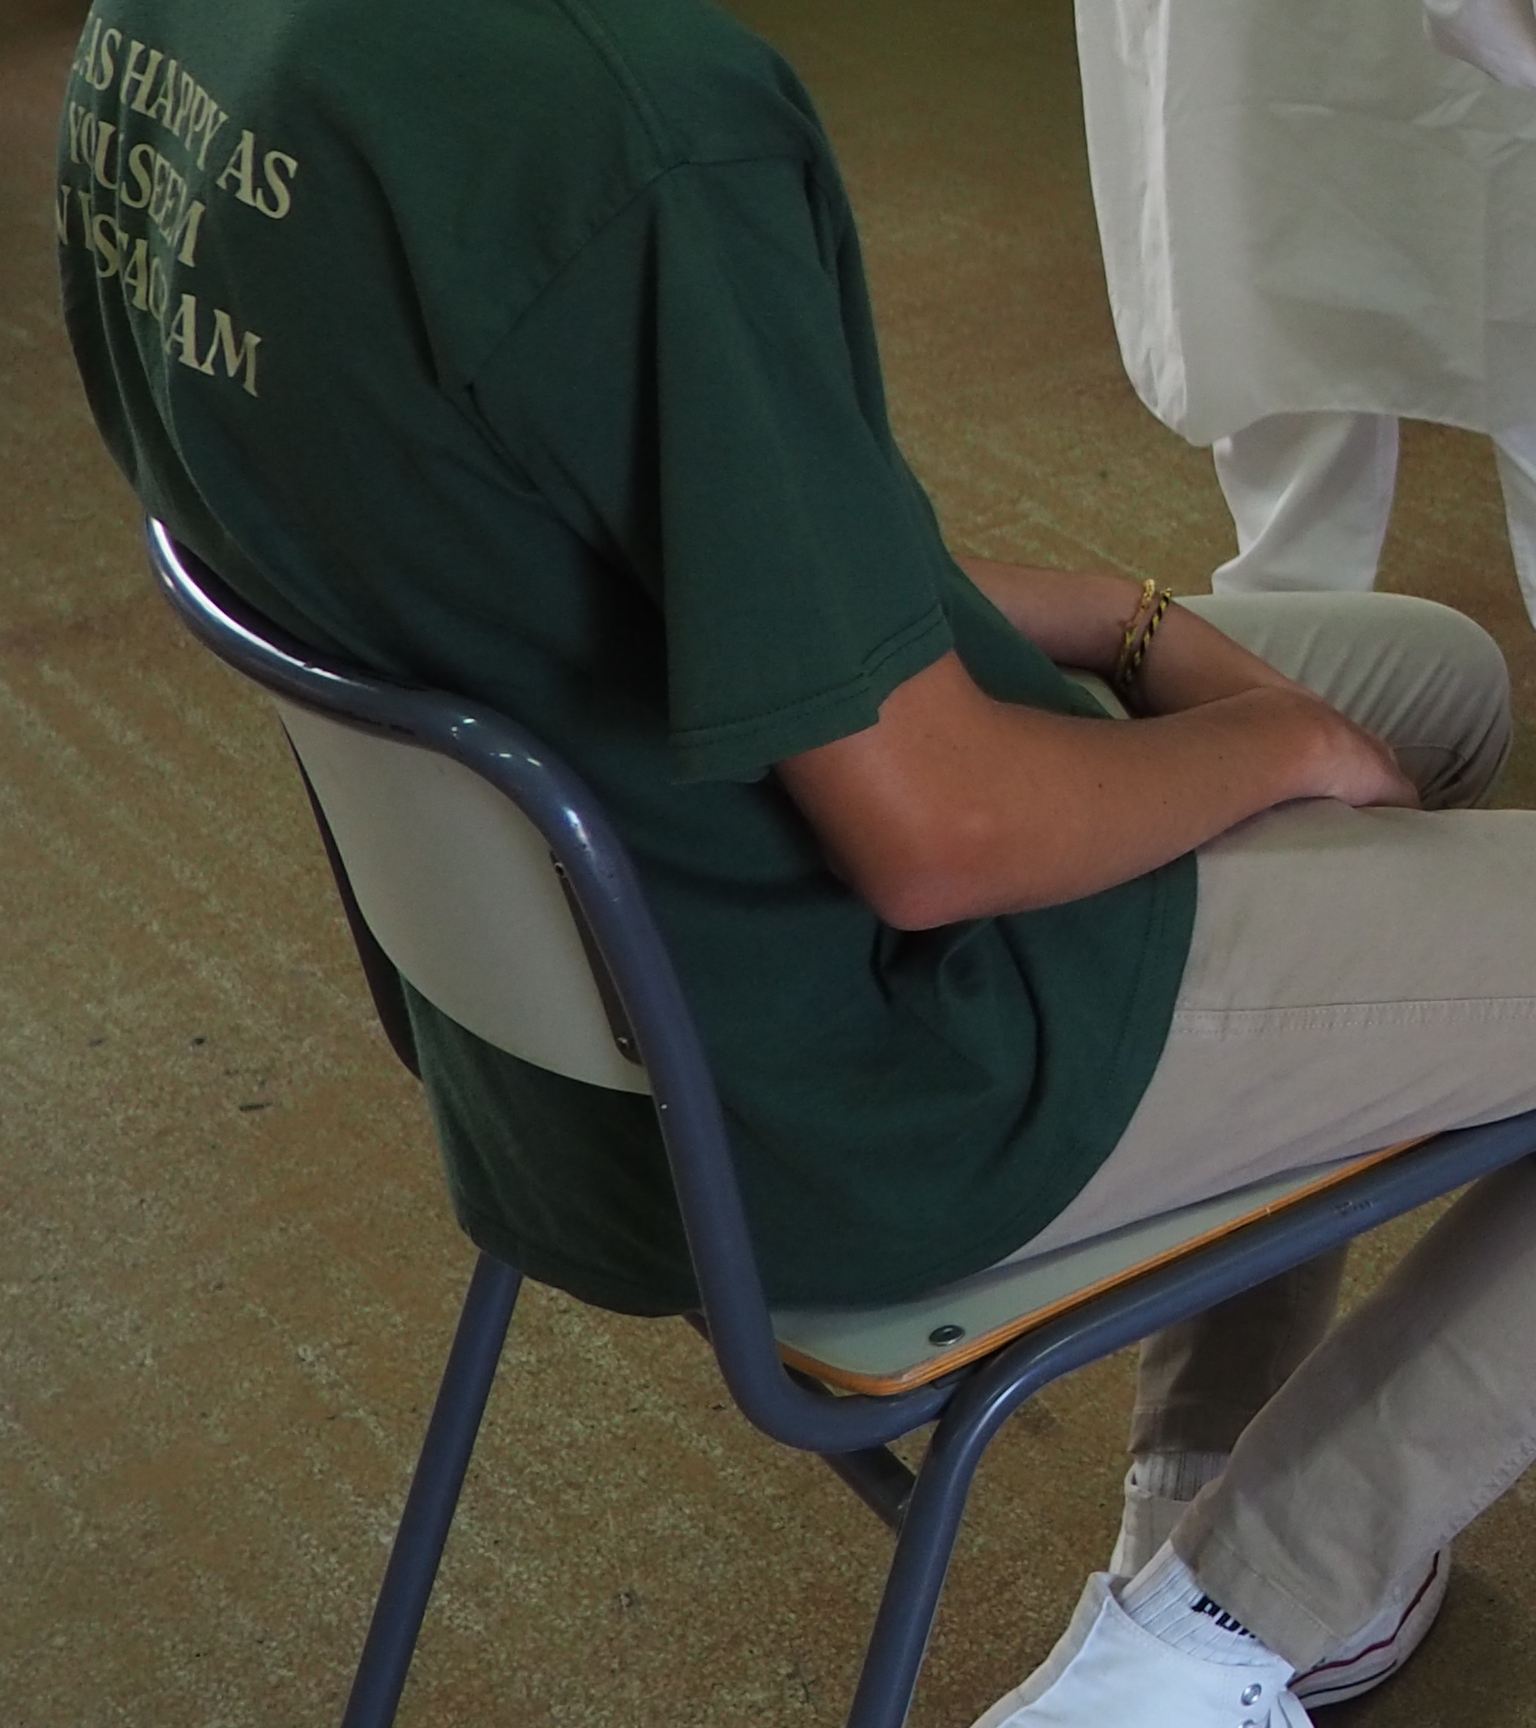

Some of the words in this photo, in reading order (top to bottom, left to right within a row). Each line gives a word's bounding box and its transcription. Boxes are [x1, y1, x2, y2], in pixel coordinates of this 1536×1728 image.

[119, 39, 230, 171] HAPPY
[216, 129, 299, 220] AS
[120, 142, 206, 269] SEEM
